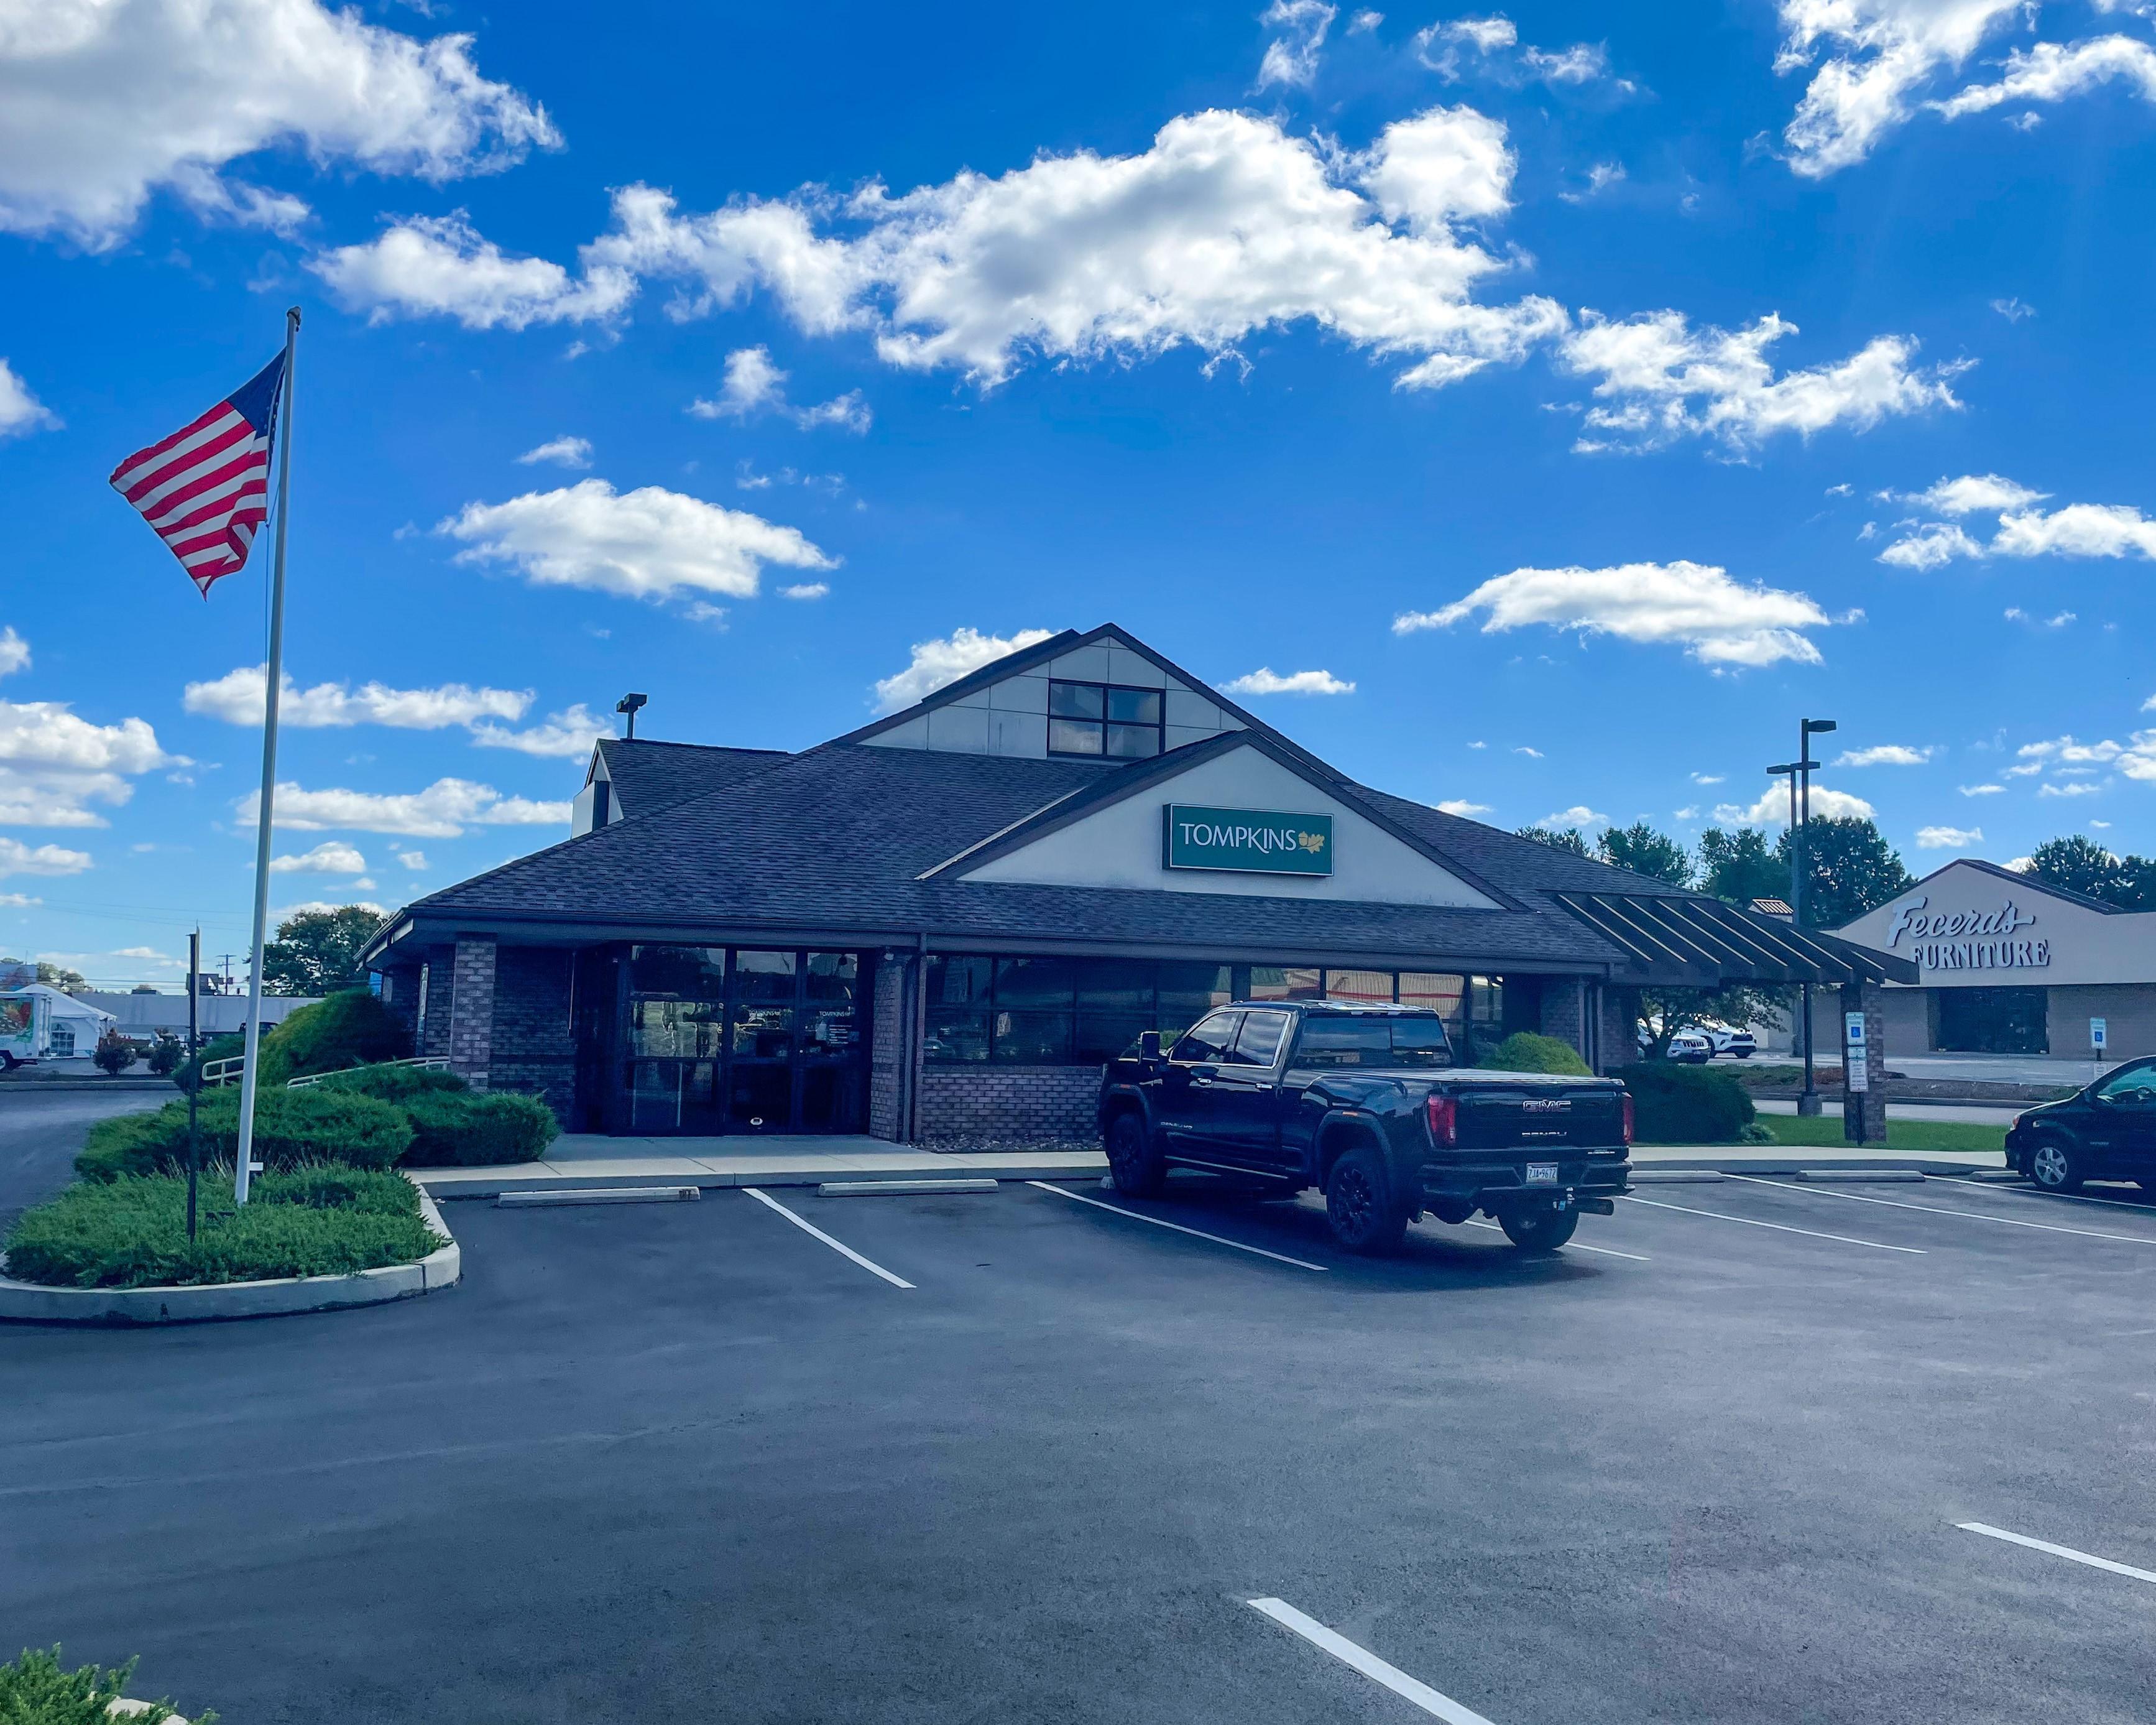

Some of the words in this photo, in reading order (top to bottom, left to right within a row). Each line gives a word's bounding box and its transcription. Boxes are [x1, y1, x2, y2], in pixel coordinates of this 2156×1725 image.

[1179, 823, 1296, 854] TOMPKINS
[1886, 897, 2035, 947] Fecera's
[1910, 940, 2051, 969] FURNITURE
[1523, 1100, 1572, 1112] GMC
